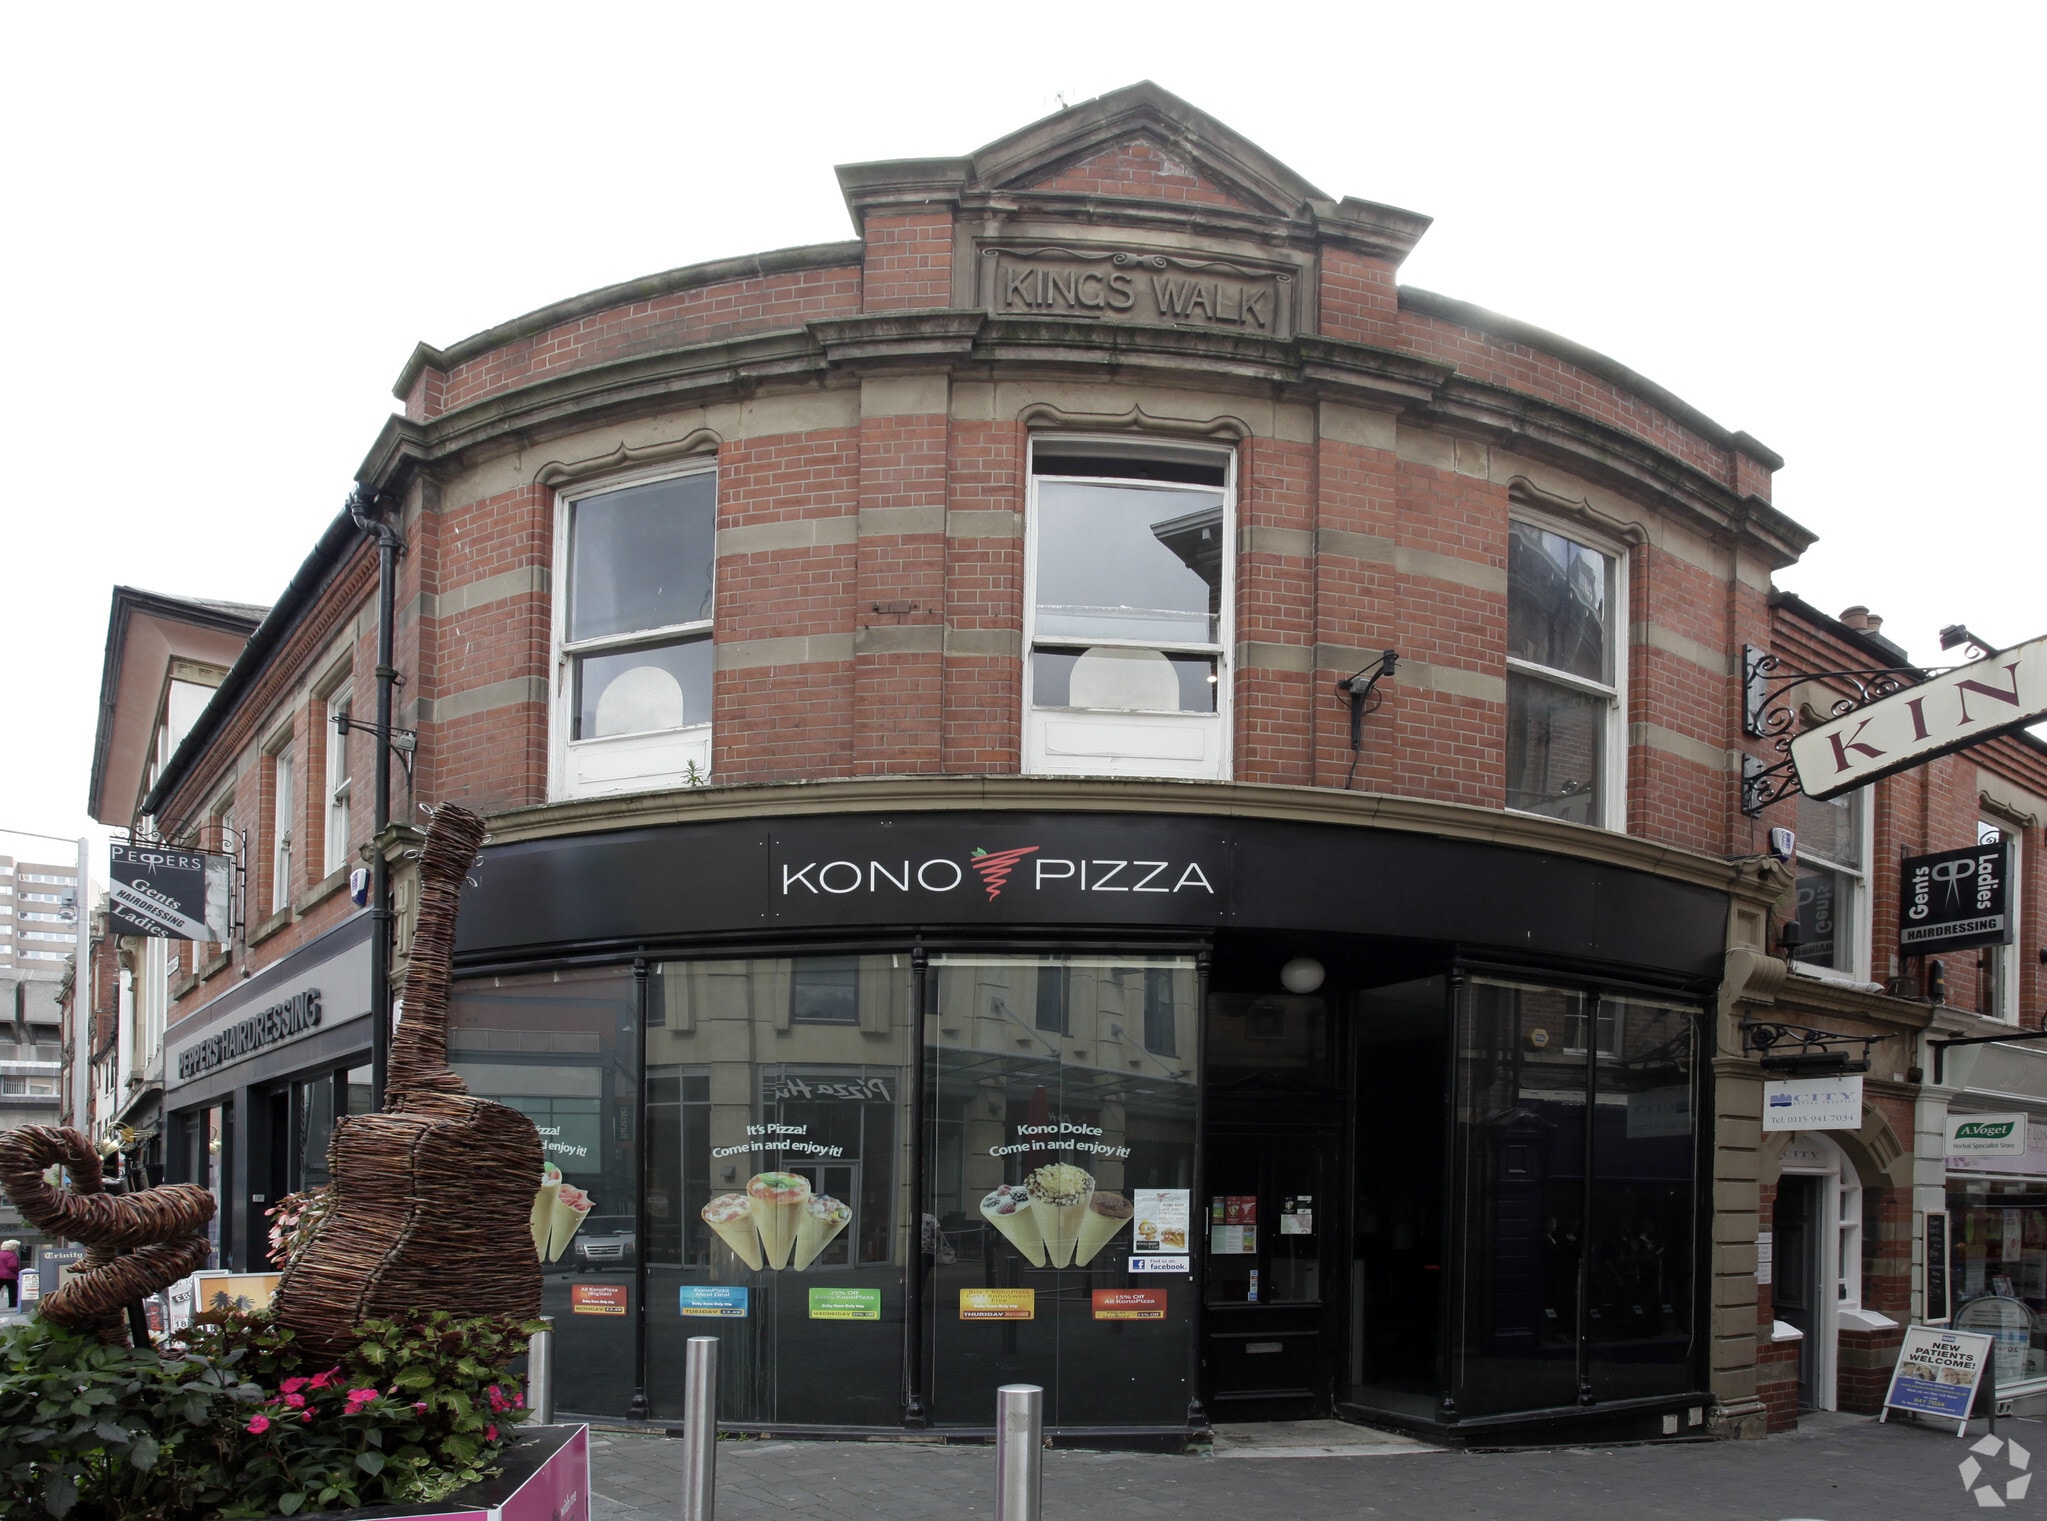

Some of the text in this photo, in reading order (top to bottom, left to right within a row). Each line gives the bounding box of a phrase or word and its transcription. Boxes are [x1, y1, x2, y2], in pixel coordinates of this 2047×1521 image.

[1005, 267, 1269, 328] KINGS WALK
[783, 859, 1215, 895] KONO PIZZA
[1976, 853, 1999, 910] Ladies
[131, 879, 181, 910] Gents
[1908, 866, 1930, 919] Gents
[116, 889, 185, 928] HAIRDRESSING
[111, 903, 168, 938] Ladies
[1907, 919, 1997, 940] HAIRDRESSING
[178, 987, 321, 1079] PEPPERS HAIRDRESSING
[1793, 1092, 1855, 1101] CITY
[536, 1125, 560, 1135] izza!
[767, 1123, 807, 1135] Pizza!
[1017, 1122, 1103, 1136] Kono Dolce
[1961, 1125, 2007, 1136] A.Vogel
[548, 1142, 576, 1156] enjoy
[575, 1146, 588, 1157] it!
[712, 1139, 843, 1158] Come in and enjoy it!
[989, 1139, 1131, 1158] Come in and enjoy it!
[1915, 1347, 1974, 1361] PATIENTS
[1932, 1342, 1961, 1351] NEW
[1909, 1354, 1976, 1369] WELCOME!
